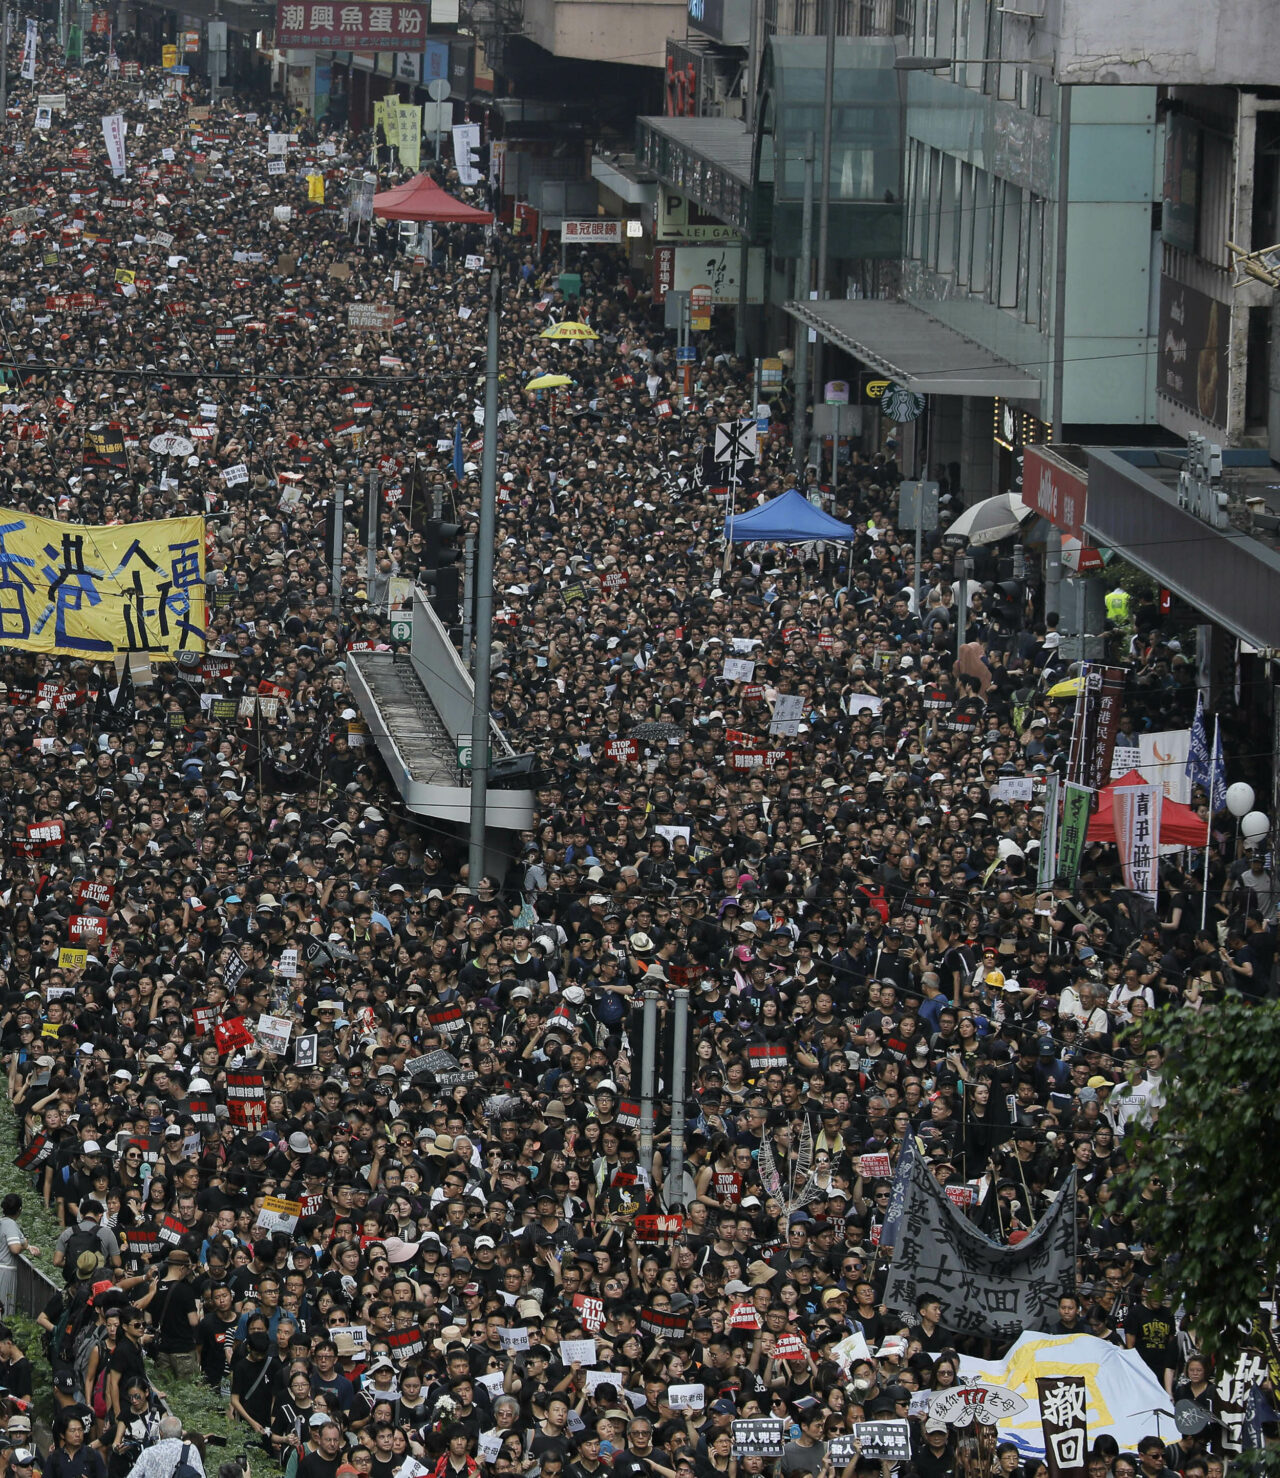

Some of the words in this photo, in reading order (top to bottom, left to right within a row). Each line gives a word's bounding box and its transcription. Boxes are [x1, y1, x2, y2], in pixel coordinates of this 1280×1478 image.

[281, 5, 423, 34] 潮興魚蛋粉
[667, 195, 682, 216] P
[566, 223, 617, 235] 皇冠眼鏡
[687, 228, 706, 237] LEI
[660, 250, 670, 282] 停車場
[602, 578, 627, 587] KILLING
[203, 663, 228, 672] KILLING
[43, 684, 58, 692] STOP
[58, 694, 77, 702] STOP
[611, 740, 631, 749] STOP
[607, 747, 635, 756] KILLING
[767, 751, 785, 759] STOP
[87, 882, 108, 894] STOP
[80, 890, 110, 903] KILLING
[76, 916, 100, 926] STOP
[718, 1174, 733, 1185] STOP
[715, 1184, 738, 1194] KILLING
[586, 1318, 600, 1331] US
[956, 1389, 989, 1405] 777
[1042, 1382, 1086, 1469] 撤回
